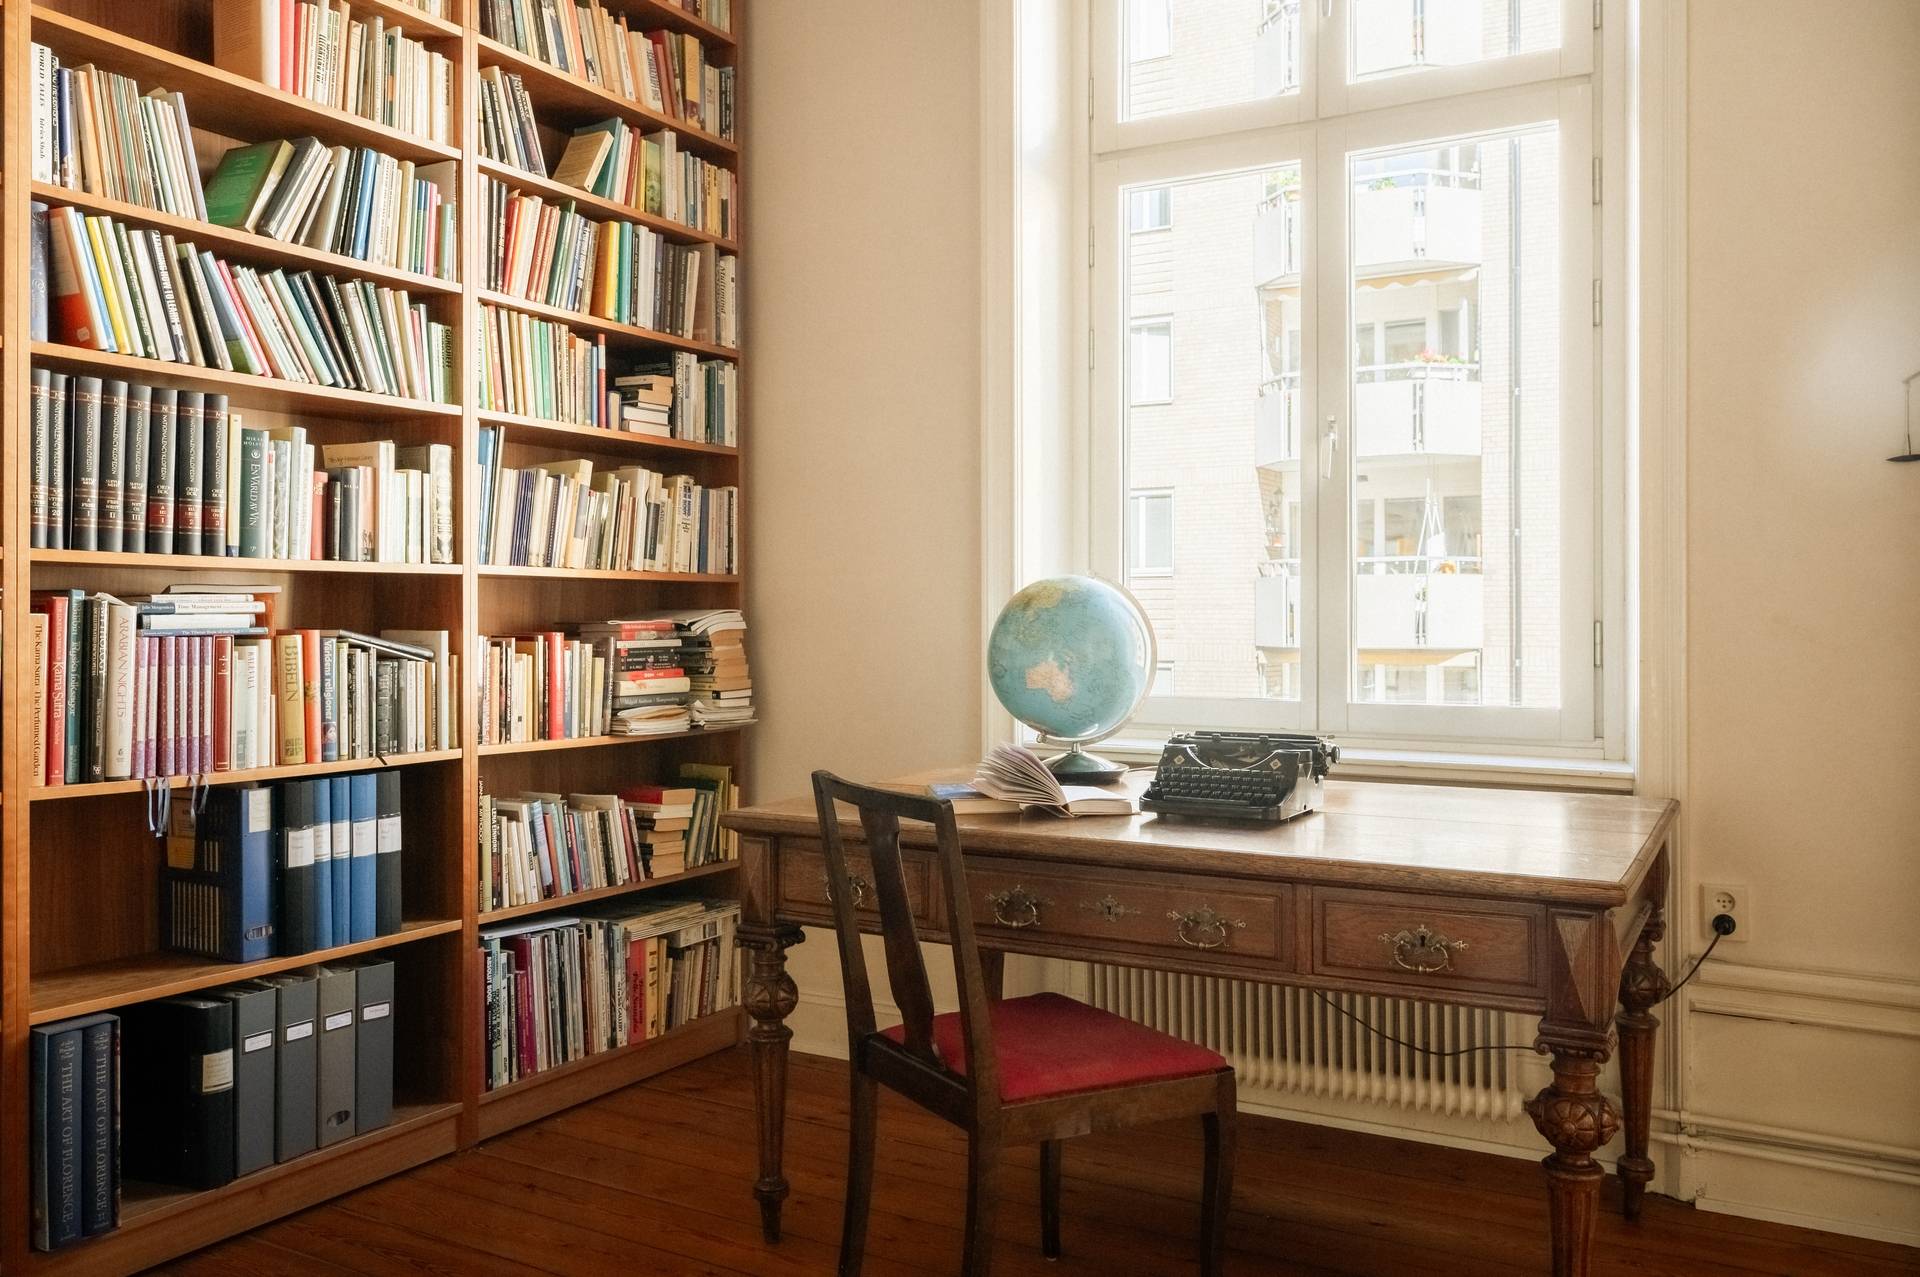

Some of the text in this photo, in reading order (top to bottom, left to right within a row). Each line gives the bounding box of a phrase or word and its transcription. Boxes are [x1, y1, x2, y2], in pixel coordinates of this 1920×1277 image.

[152, 233, 180, 323] LEARNING HOW TO LEARN
[251, 464, 261, 474] EN
[249, 512, 259, 526] VIN
[70, 640, 80, 668] Ryska
[117, 617, 128, 717] ARABIAN NIGHTS
[34, 666, 42, 686] Sutra
[284, 645, 299, 701] BIBELN
[324, 640, 333, 720] Världens religioner
[34, 690, 42, 705] The
[52, 661, 64, 719] Kama Sutra
[68, 671, 79, 716] folksagor
[33, 747, 41, 776] Garden
[62, 1063, 73, 1091] THE
[96, 1054, 107, 1083] THE
[62, 1096, 72, 1122] ART
[96, 1088, 106, 1111] ART
[62, 1126, 73, 1145] OF
[96, 1116, 106, 1138] OF
[62, 1149, 73, 1221] FLORENCE
[96, 1141, 107, 1210] FLORENCE
